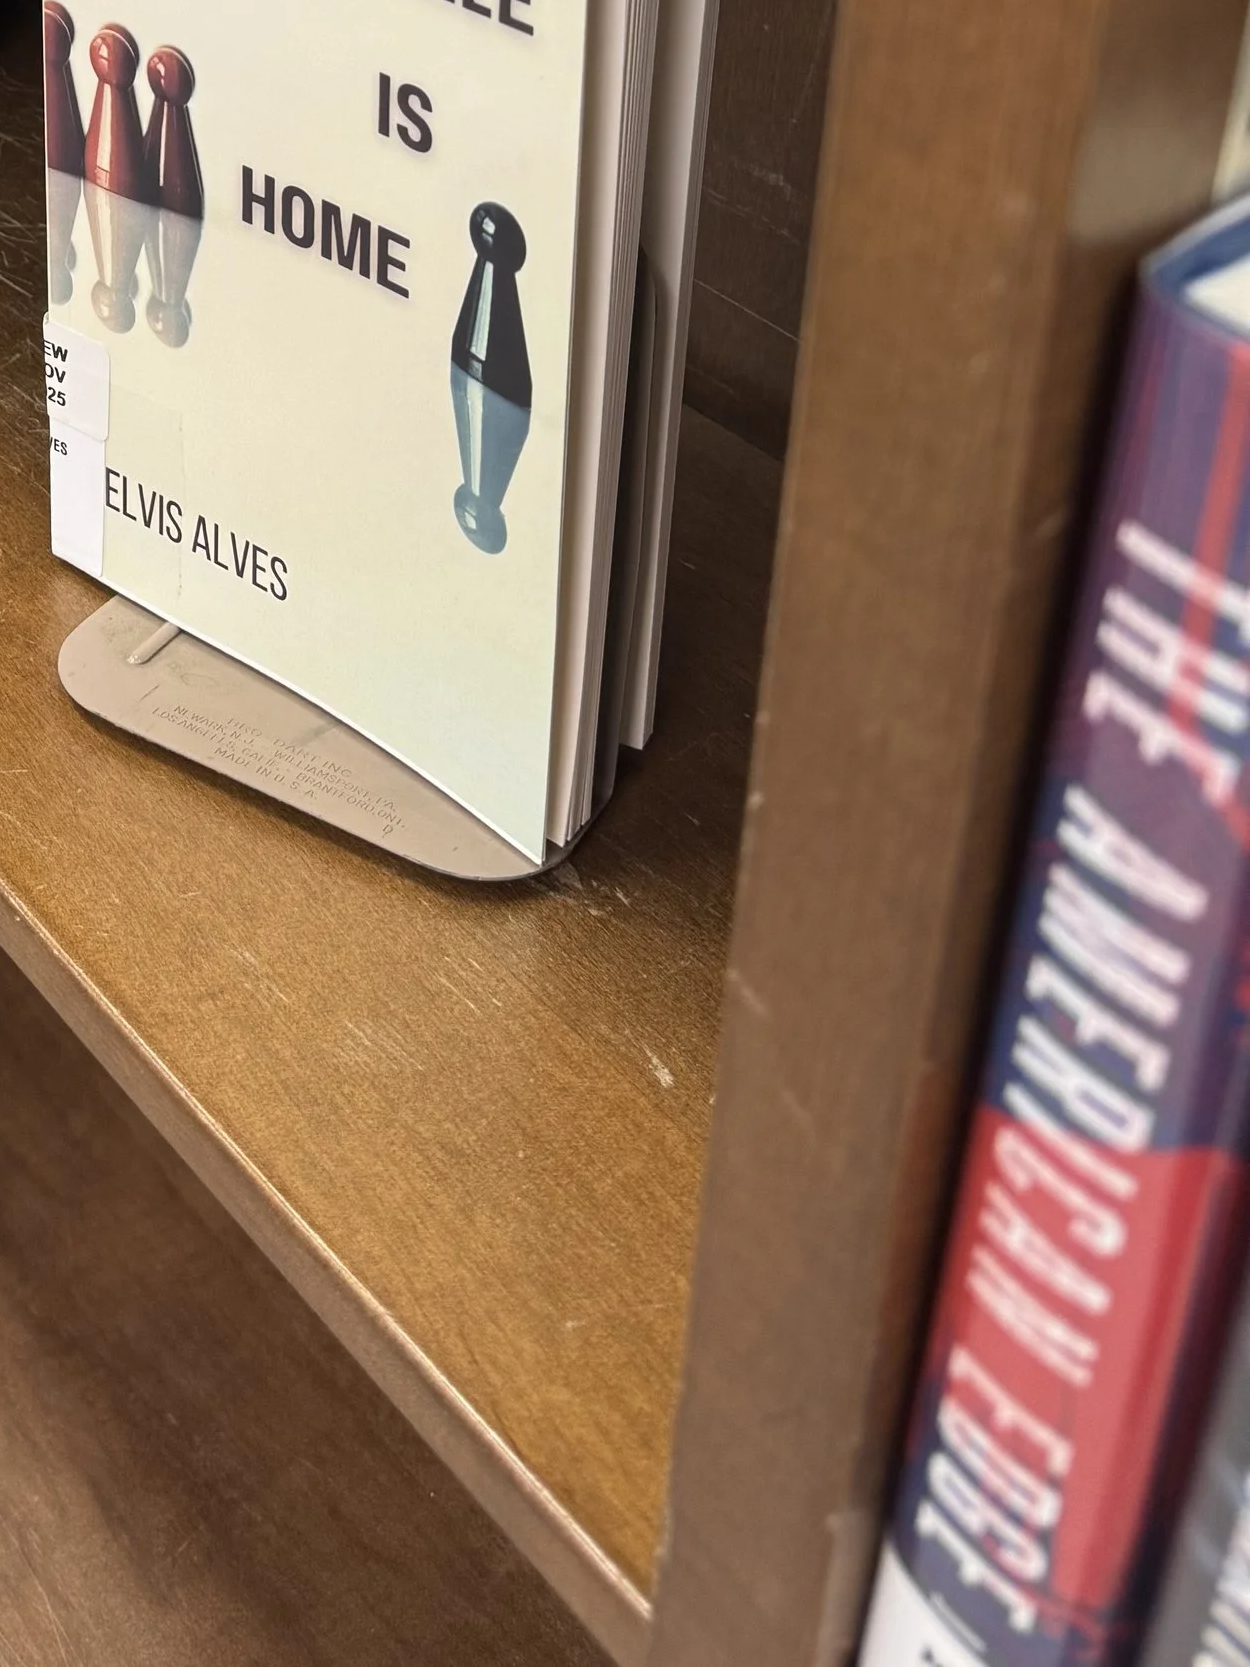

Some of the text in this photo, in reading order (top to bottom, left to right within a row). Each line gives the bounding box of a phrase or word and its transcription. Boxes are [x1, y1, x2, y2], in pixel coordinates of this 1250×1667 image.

[378, 71, 433, 154] IS
[241, 164, 411, 300] HOME
[105, 466, 288, 601] ELVIS ALVES
[964, 783, 1209, 1389] AMERICAN
